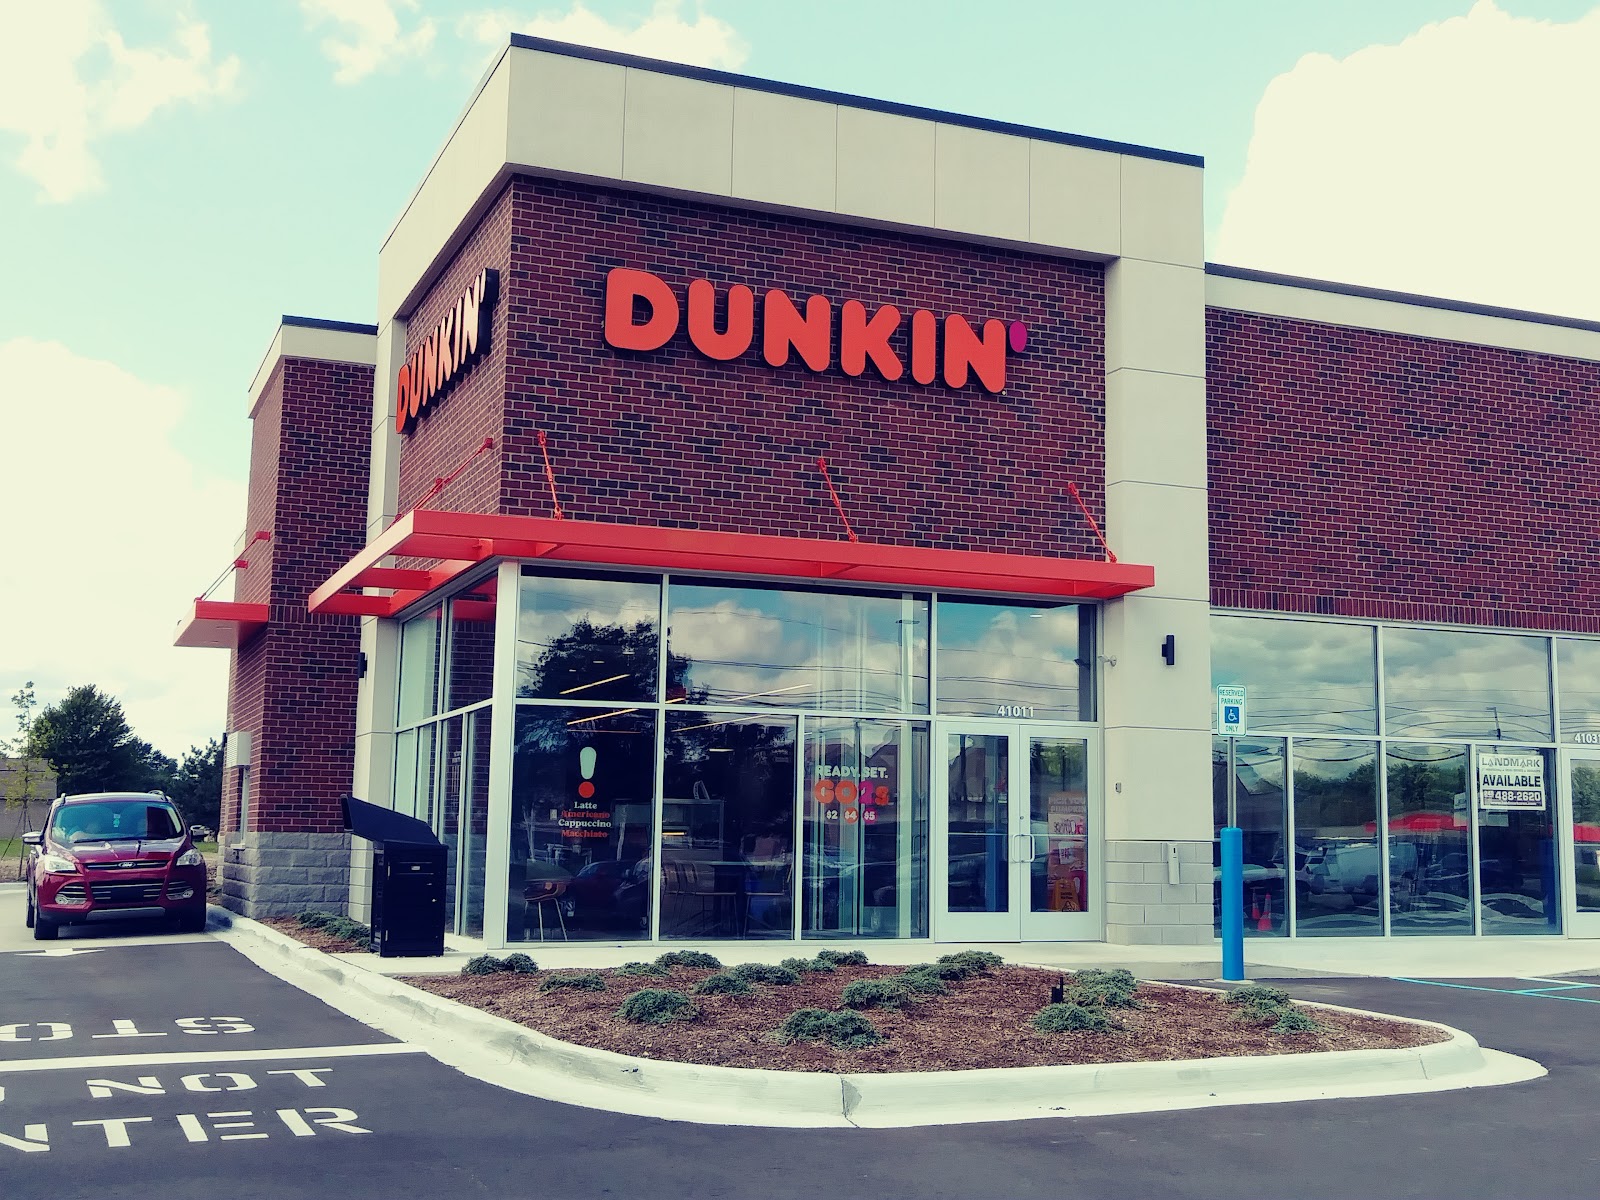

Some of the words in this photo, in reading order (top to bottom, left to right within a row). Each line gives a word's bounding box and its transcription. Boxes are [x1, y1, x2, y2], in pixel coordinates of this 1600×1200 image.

[604, 267, 1027, 393] DUNKIN'
[396, 267, 487, 433] DUNKIN'
[997, 705, 1034, 718] 41011
[1481, 757, 1541, 768] LANDMARK
[862, 766, 889, 779] SET.
[1482, 774, 1542, 787] AVAILABLE
[1495, 791, 1541, 801] 488-2620
[573, 801, 598, 810] Latte
[561, 810, 611, 819] Americano
[826, 810, 838, 820] $2
[844, 810, 858, 821] $4
[863, 811, 876, 821] $5
[558, 818, 612, 829] Cappuccino
[561, 829, 609, 838] Macchiato
[86, 1068, 333, 1098] NOT
